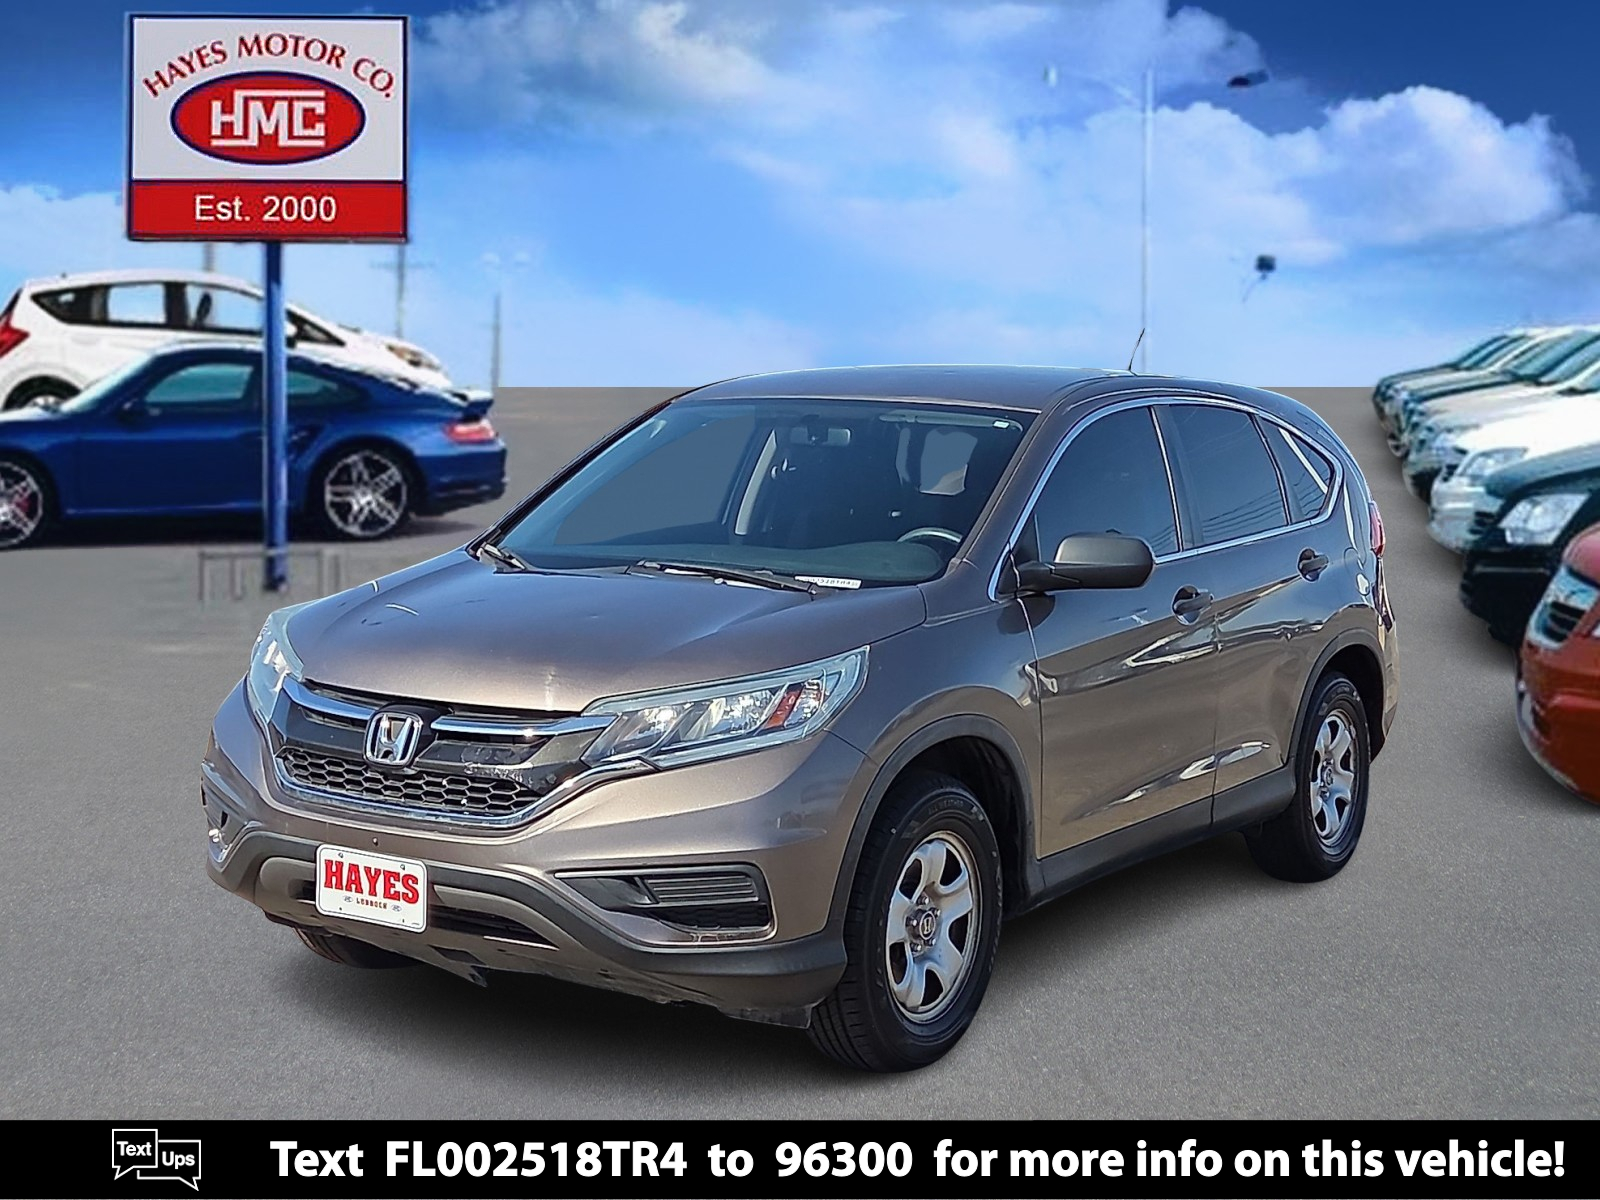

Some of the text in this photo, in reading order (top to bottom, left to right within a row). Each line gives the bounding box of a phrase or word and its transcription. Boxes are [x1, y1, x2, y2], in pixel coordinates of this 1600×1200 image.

[142, 33, 395, 99] HAYES MOTOR CO.
[209, 89, 326, 148] HMC
[194, 195, 337, 222] Est. 2000
[324, 858, 420, 905] HAYES
